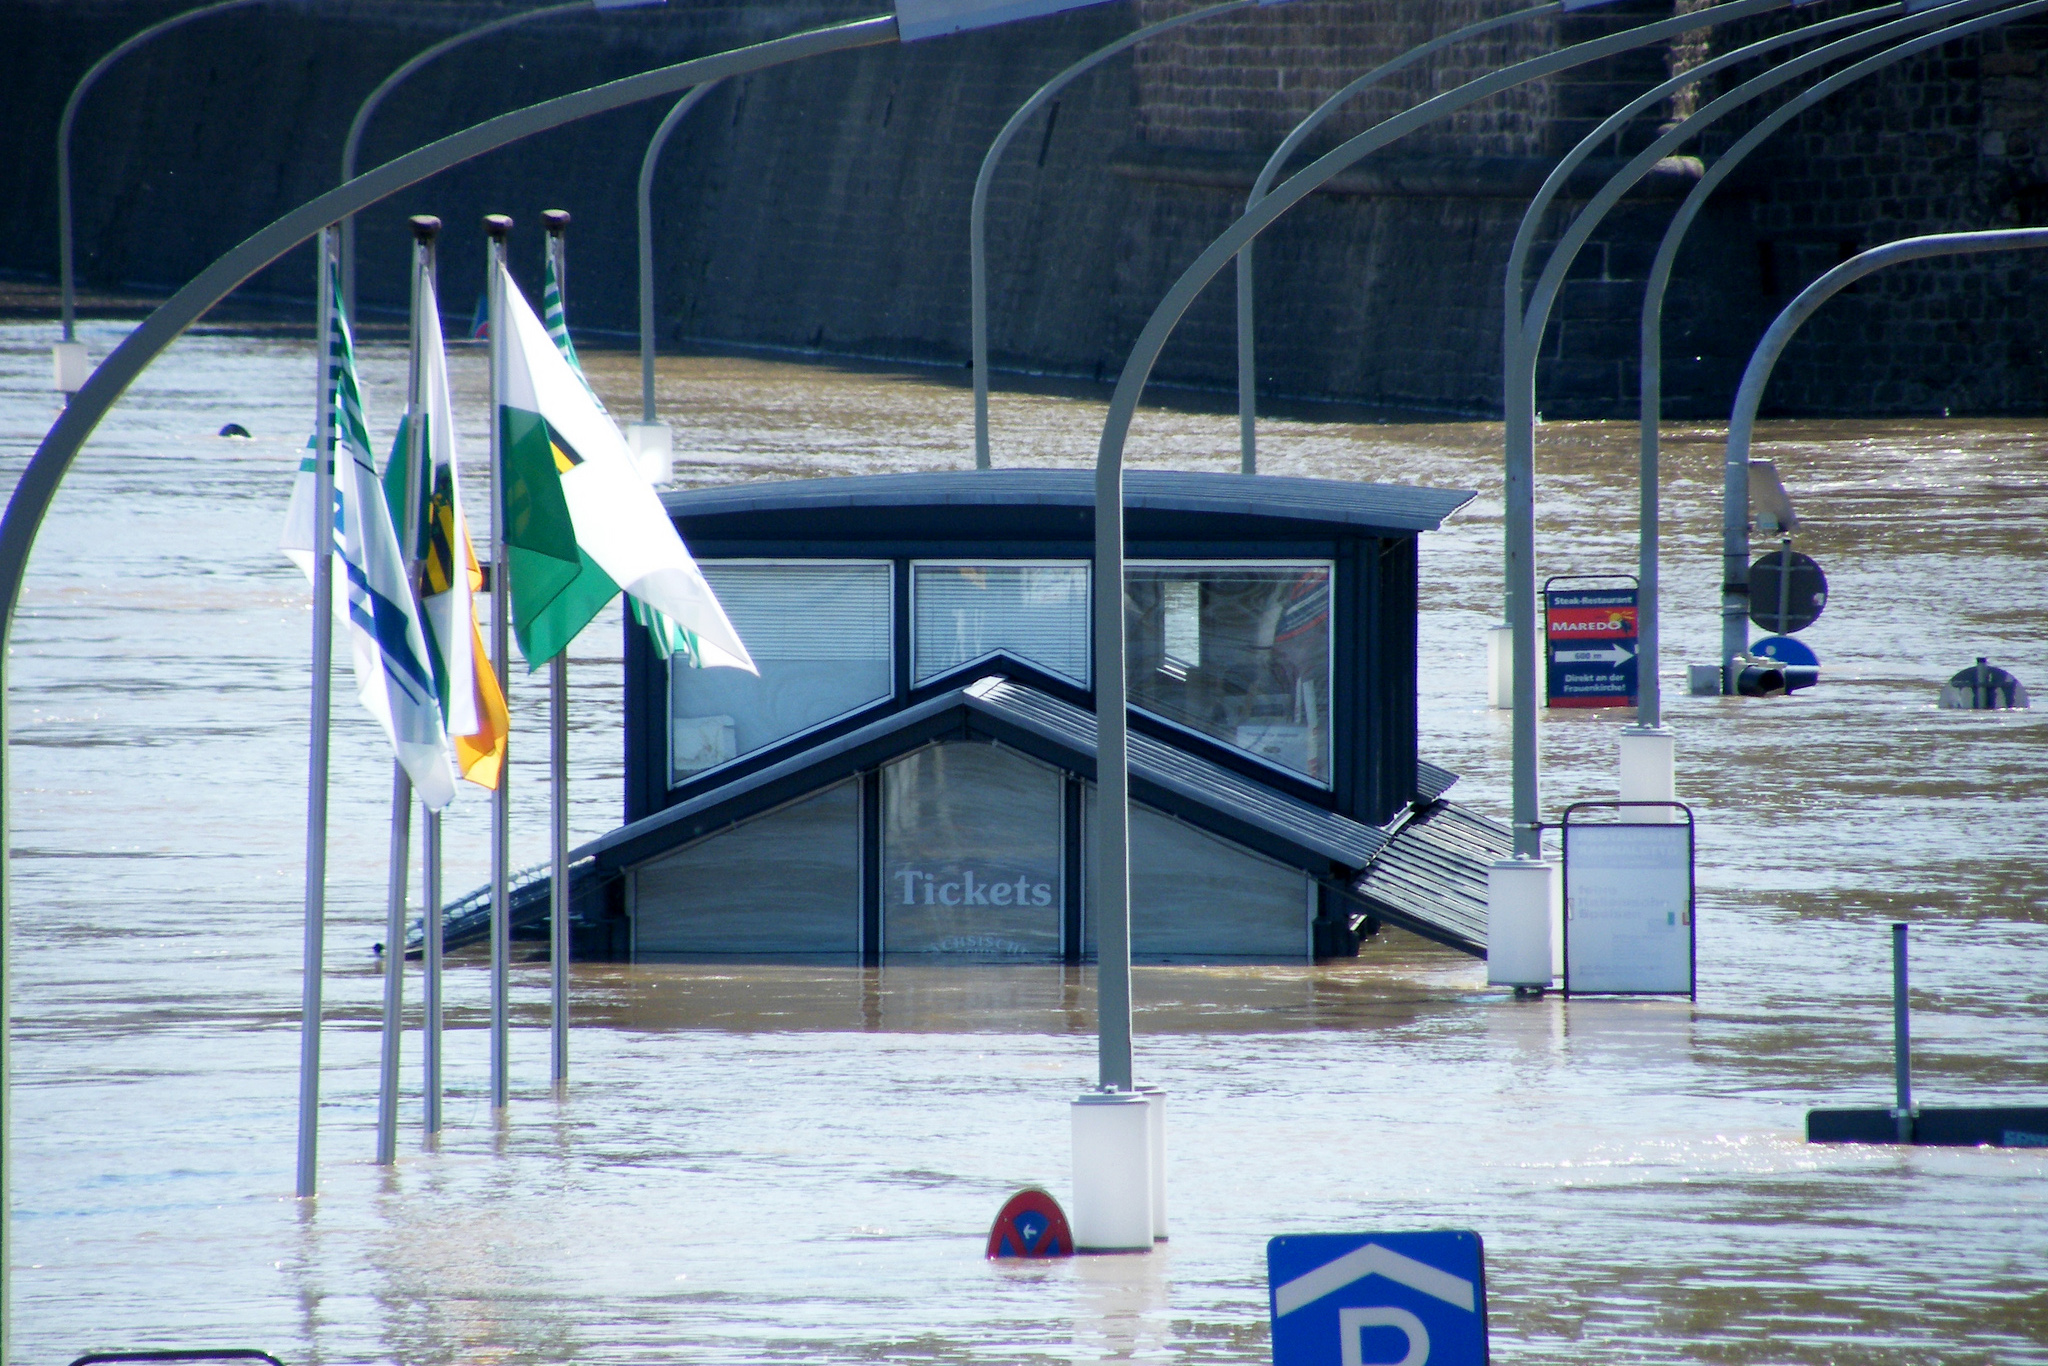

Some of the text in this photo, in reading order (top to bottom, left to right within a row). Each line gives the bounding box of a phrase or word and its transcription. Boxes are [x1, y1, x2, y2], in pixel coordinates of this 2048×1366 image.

[1554, 597, 1632, 605] Steak-Restaurant
[1552, 621, 1621, 631] MAREDO
[1565, 674, 1594, 682] Direkt
[894, 870, 1052, 906] Tickets
[1339, 1306, 1431, 1366] P
